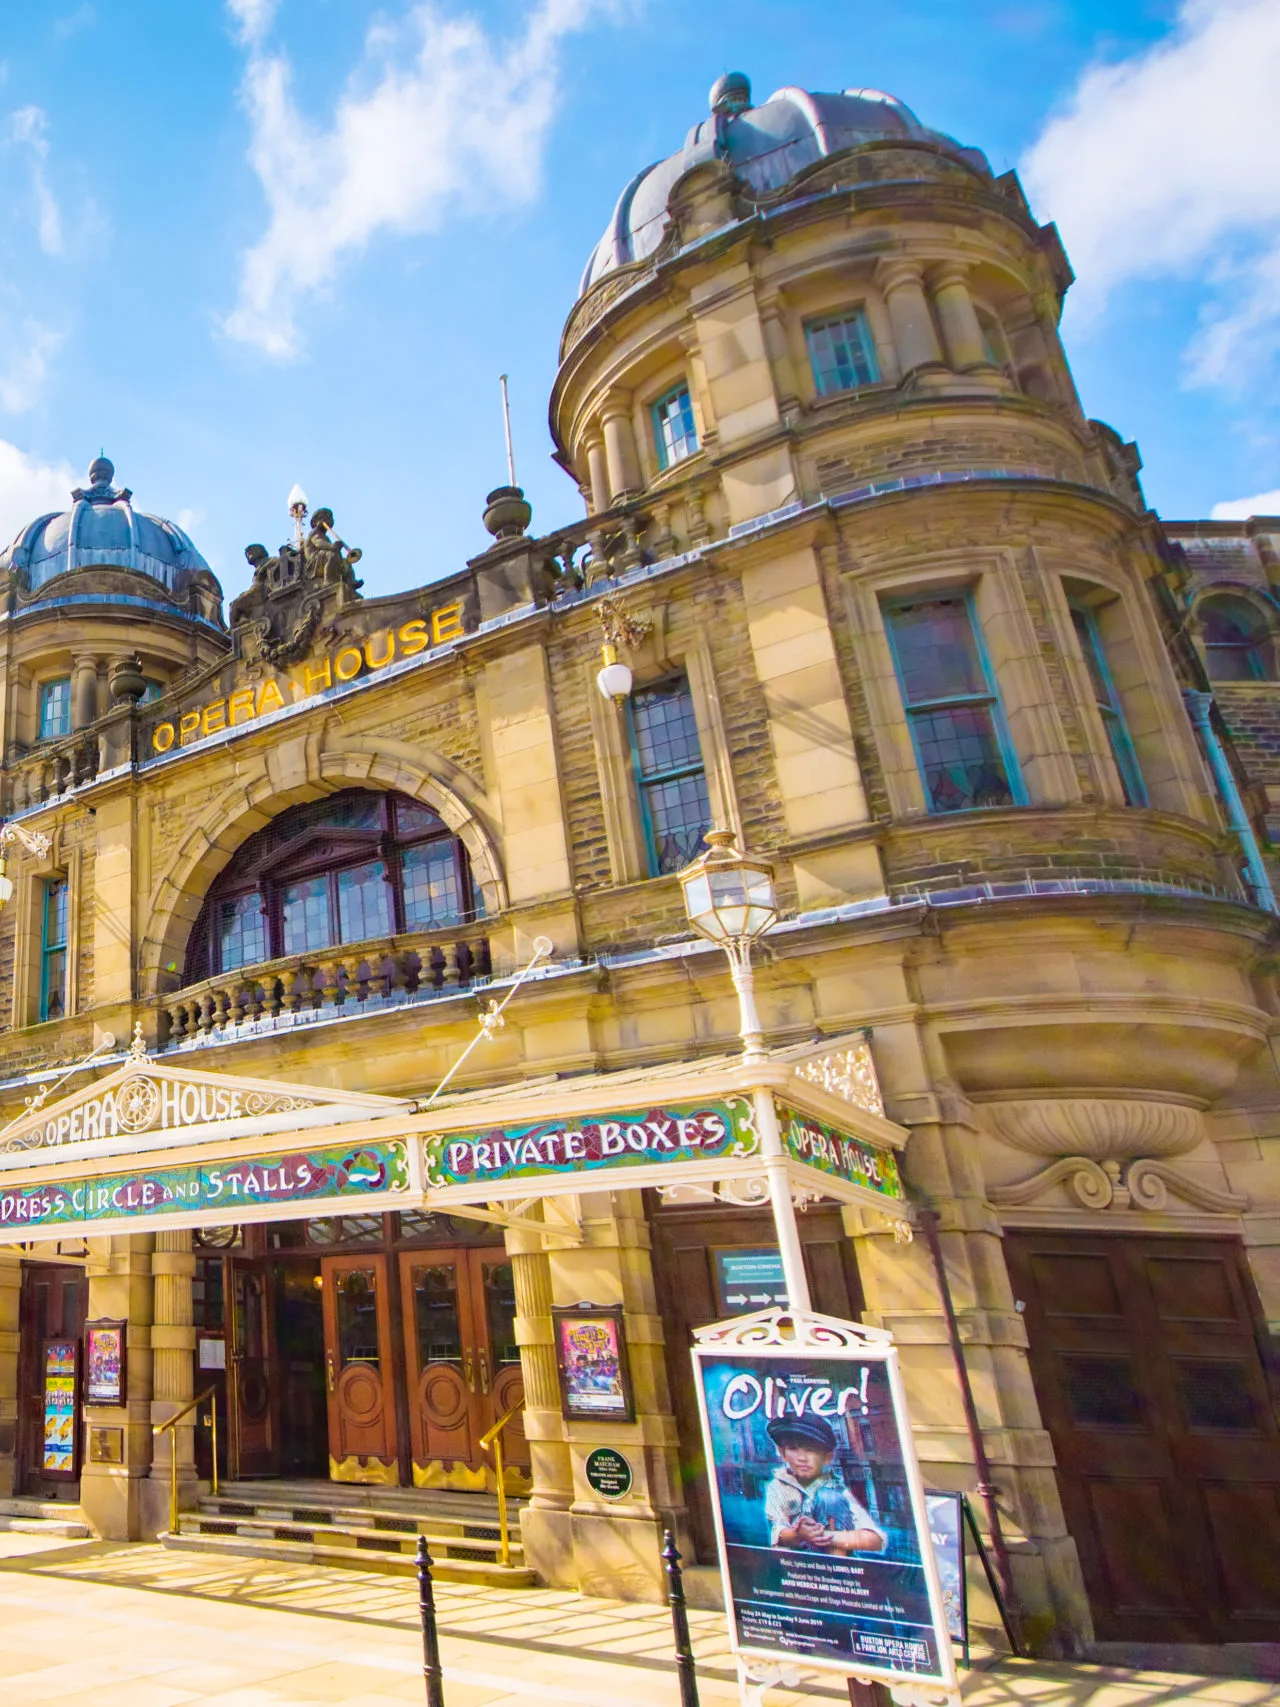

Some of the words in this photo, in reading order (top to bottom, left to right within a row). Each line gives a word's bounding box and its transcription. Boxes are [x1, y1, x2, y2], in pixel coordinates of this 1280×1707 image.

[152, 679, 285, 752] OPERA
[304, 602, 465, 695] HOUSE
[45, 1091, 117, 1146] OPERA
[160, 1081, 243, 1129] HOUSE
[448, 1130, 586, 1173] PRIVATE
[600, 1114, 726, 1156] BOXES
[790, 1120, 840, 1166] OPERA
[839, 1140, 882, 1182] HOUSE
[1, 1192, 65, 1221] DRESS
[72, 1182, 156, 1212] CIRCLE
[163, 1181, 200, 1200] AND
[205, 1163, 312, 1200] STALLS
[723, 1367, 869, 1420] Oliver!
[796, 1580, 818, 1590] MERRICK
[819, 1583, 830, 1591] AND
[830, 1584, 849, 1594] DONALD
[832, 1564, 850, 1573] LIONEL
[850, 1566, 864, 1574] BART
[741, 1608, 754, 1617] Friday
[777, 1614, 794, 1624] Sunday
[856, 1643, 861, 1651] &
[861, 1643, 888, 1655] PAVILION
[889, 1648, 903, 1656] ARTS
[904, 1649, 927, 1660] CENTRE
[860, 1635, 884, 1646] BUXTON
[884, 1638, 904, 1649] OPERA
[904, 1642, 925, 1652] HOUSE
